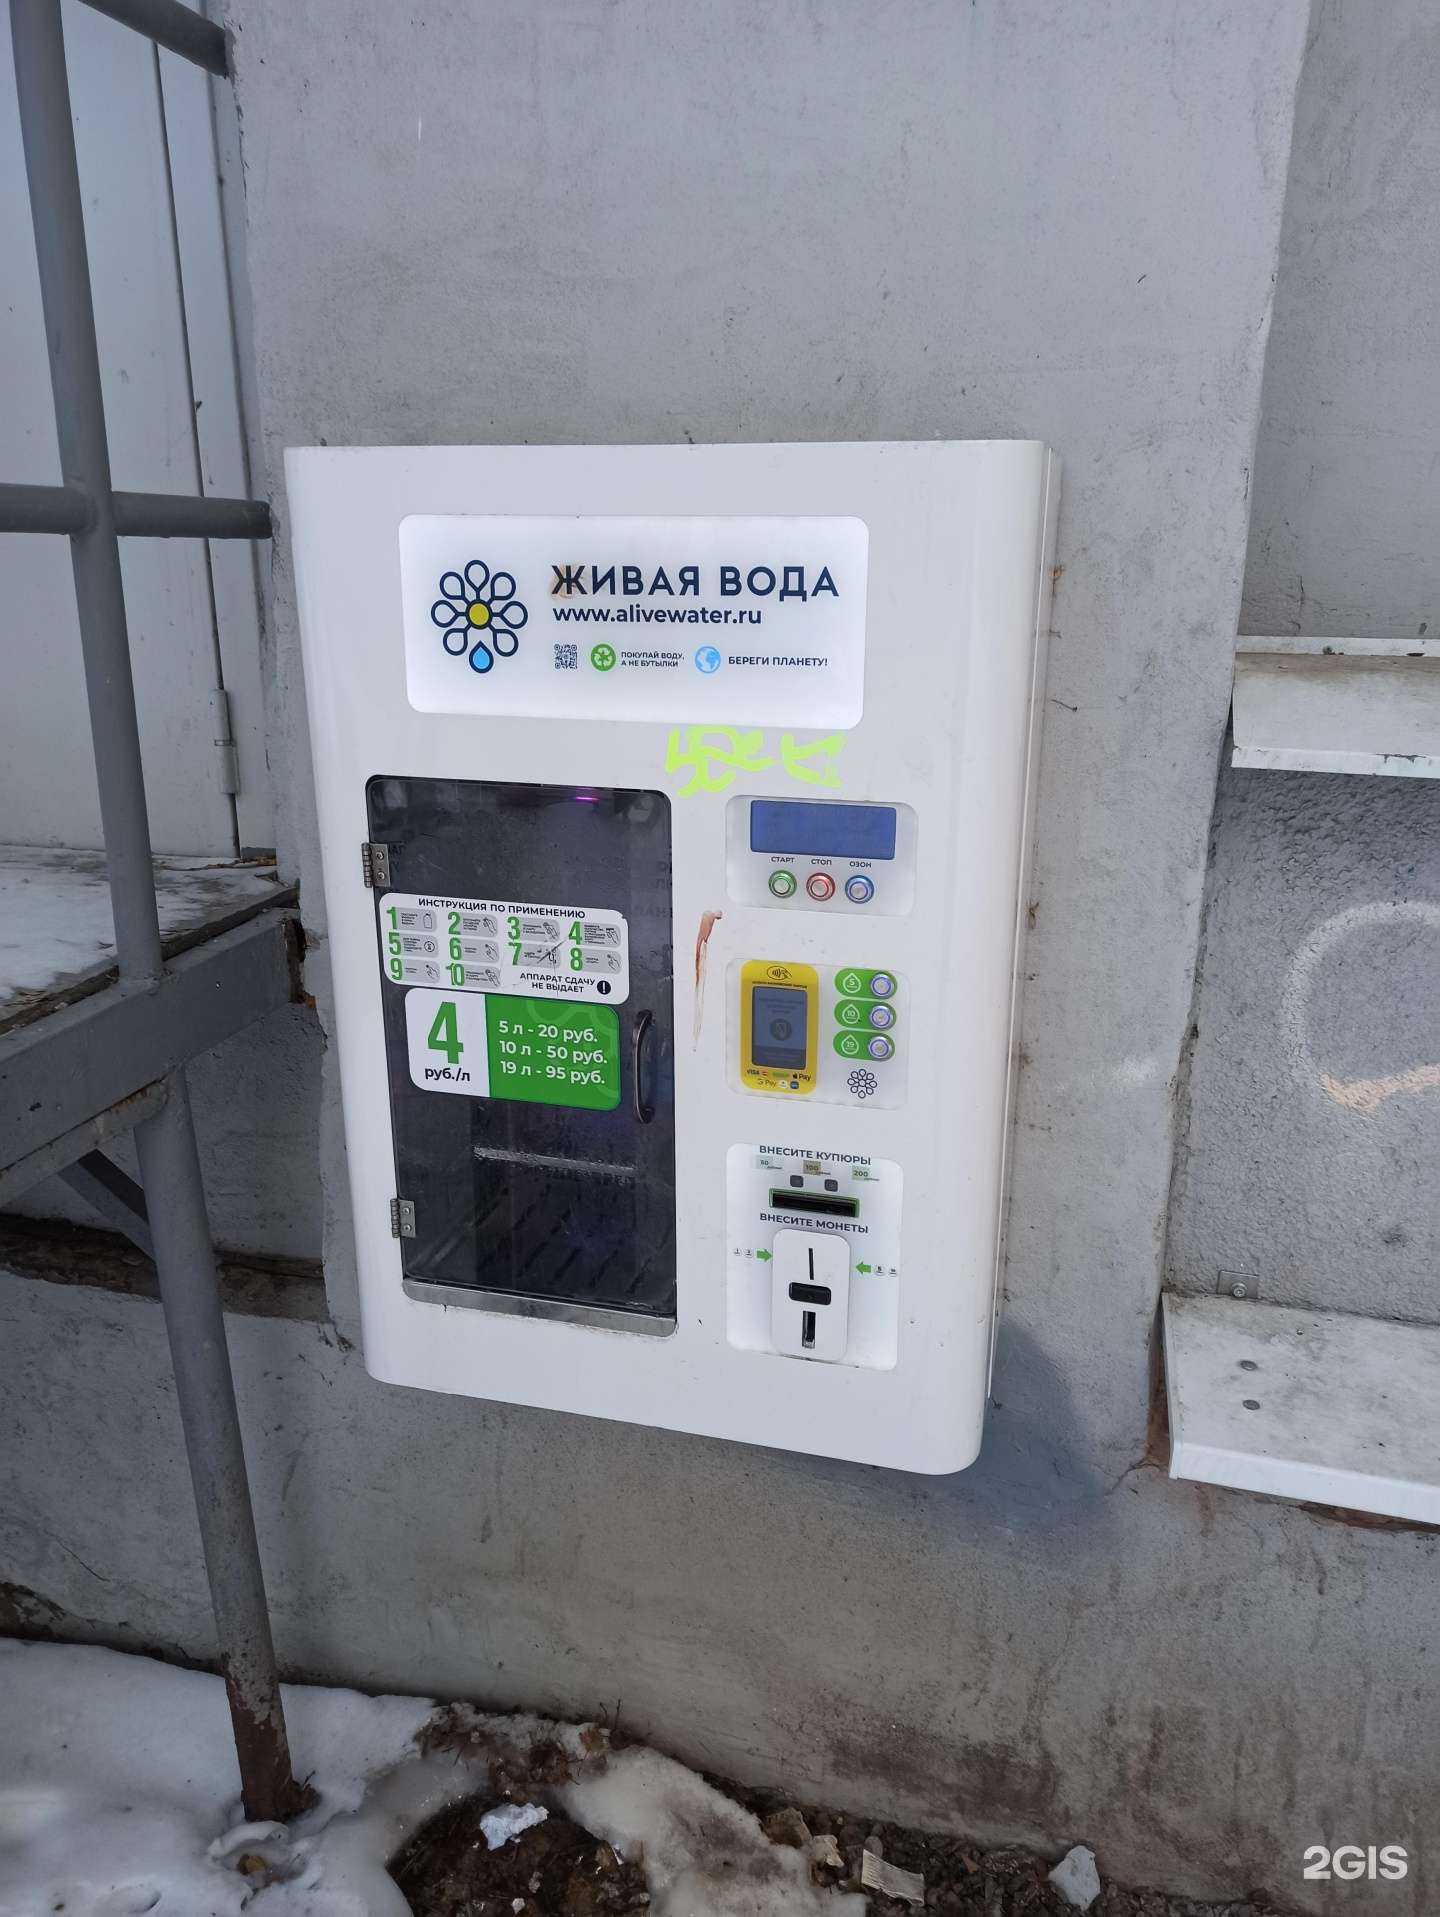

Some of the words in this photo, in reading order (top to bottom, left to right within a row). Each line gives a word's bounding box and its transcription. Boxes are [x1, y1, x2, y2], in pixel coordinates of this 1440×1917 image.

[551, 565, 700, 596] ЖИВАЯ
[720, 566, 839, 602] ВОДА
[553, 604, 762, 625] www.alivewater.ru
[621, 651, 660, 659] ПОКУПАЙ
[661, 651, 684, 660] ВОДУ,
[640, 660, 678, 668] БУТЫЛКИ
[728, 656, 770, 665] БЕРЕГИ
[772, 657, 828, 667] ПЛАНЕТУ!
[386, 906, 398, 930] 1
[418, 898, 487, 911] ИНСТРУКЦИЯ
[490, 904, 505, 913] ПО
[508, 905, 585, 919] ПРИМЕНЕНИЮ
[447, 911, 461, 935] 2
[507, 916, 520, 940] 3
[568, 921, 583, 945] 4
[389, 931, 401, 955] 5
[449, 937, 462, 960] 6
[508, 942, 522, 966] 7
[390, 958, 402, 980] 9
[570, 947, 583, 971] 8
[445, 963, 465, 986] 10
[520, 973, 563, 982] АППАРАТ
[564, 977, 596, 986] СДАЧУ
[532, 982, 545, 990] НЕ
[546, 984, 584, 993] ВЫДАЕТ
[427, 1001, 464, 1065] 4
[499, 1020, 509, 1034] 5
[512, 1024, 523, 1035] л
[538, 1024, 558, 1038] 20
[562, 1026, 598, 1044] руб.
[499, 1040, 516, 1053] 10
[519, 1045, 531, 1056] л
[546, 1046, 568, 1059] 50
[572, 1048, 607, 1065] руб.
[425, 1066, 471, 1082] руб./л
[500, 1060, 517, 1074] 19
[520, 1065, 532, 1077] л
[546, 1066, 566, 1080] 95
[570, 1069, 605, 1086] руб.
[759, 1145, 813, 1159] ВНЕСИТЕ
[816, 1152, 871, 1165] КУПЮРЫ
[759, 1213, 813, 1226] ВНЕСИТЕ
[816, 1220, 868, 1233] МОНЕТЫ
